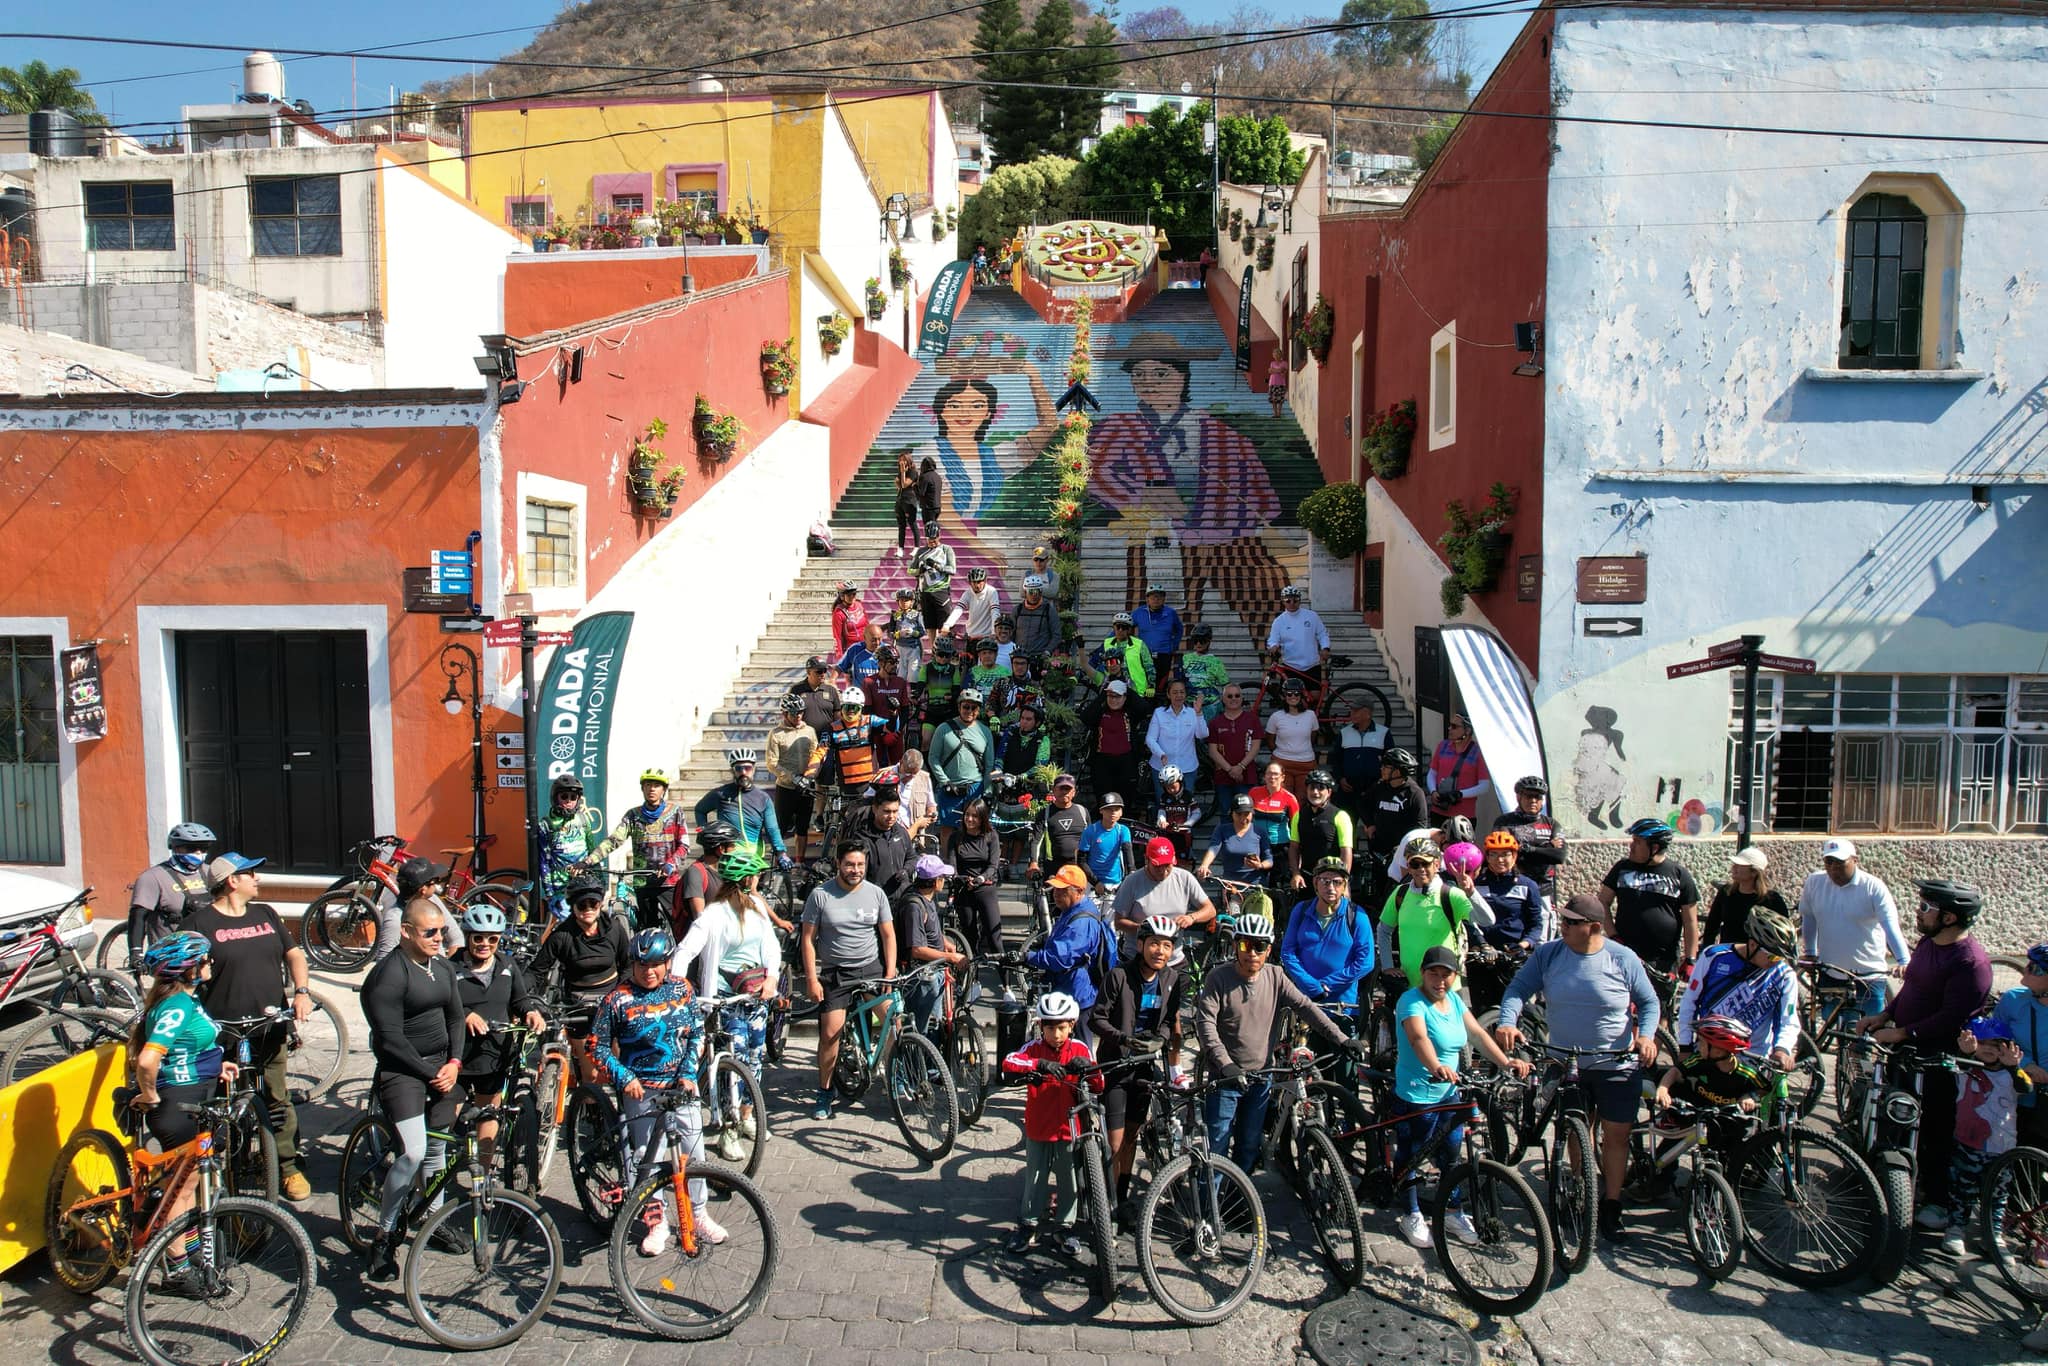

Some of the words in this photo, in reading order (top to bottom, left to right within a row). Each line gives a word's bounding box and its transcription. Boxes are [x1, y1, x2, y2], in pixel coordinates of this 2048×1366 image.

[931, 270, 955, 314] RODADA
[942, 271, 962, 316] PATRIMONIAL
[1599, 575, 1627, 584] Hidalgo
[549, 648, 589, 780] RODADA
[583, 648, 614, 778] PATRIMONIAL
[1379, 800, 1399, 812] PUMA
[1697, 1086, 1736, 1105] adidas
